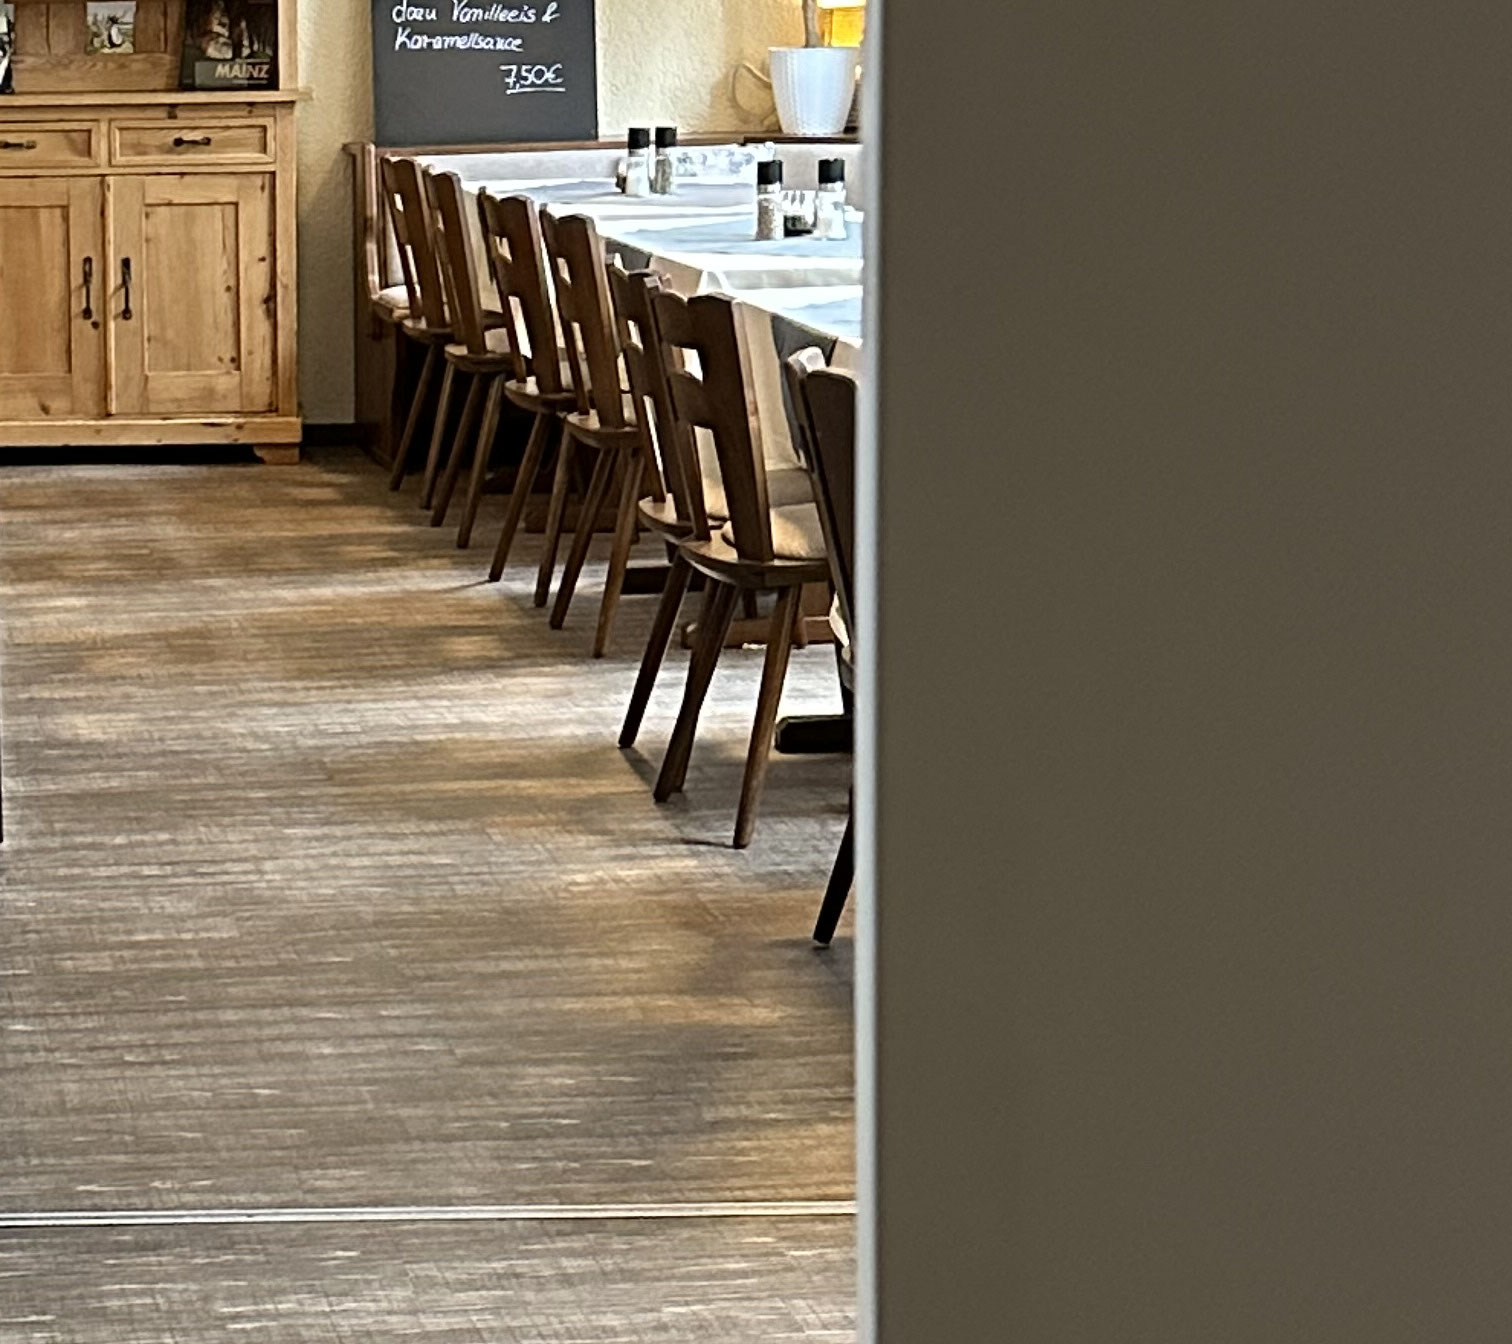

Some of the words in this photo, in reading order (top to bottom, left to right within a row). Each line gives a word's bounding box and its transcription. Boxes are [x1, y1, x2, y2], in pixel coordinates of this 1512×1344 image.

[394, 26, 524, 52] Karamellsauce
[215, 63, 269, 78] MAINZ
[499, 63, 564, 89] 7,50€
